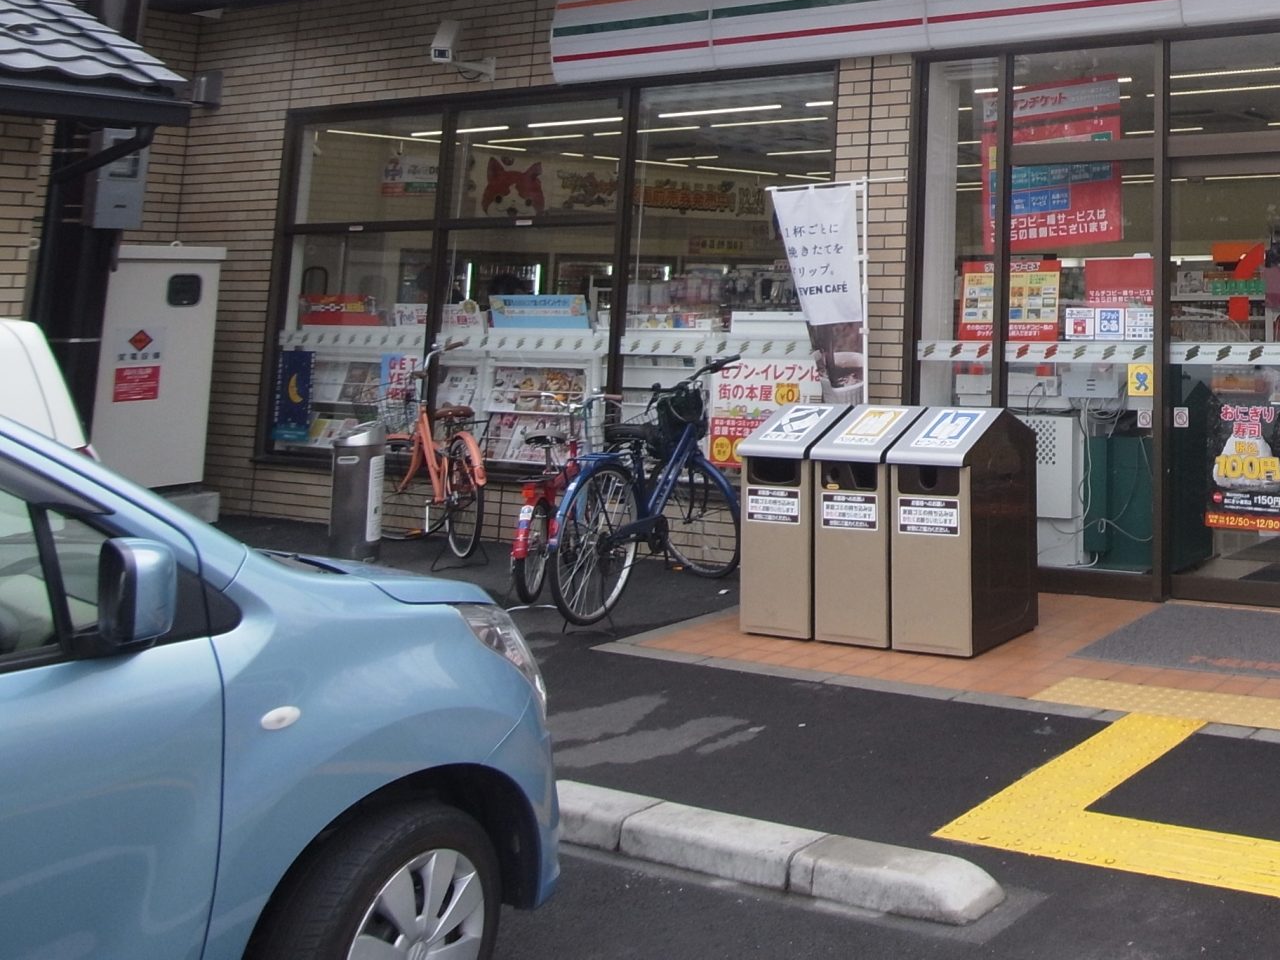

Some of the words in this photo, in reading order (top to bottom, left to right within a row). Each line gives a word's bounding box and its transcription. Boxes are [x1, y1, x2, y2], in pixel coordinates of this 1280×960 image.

[785, 223, 839, 238] 1杯ごとに
[718, 383, 773, 401] 街の本屋
[1221, 405, 1275, 423] おにぎり
[1233, 422, 1262, 438] 寿司
